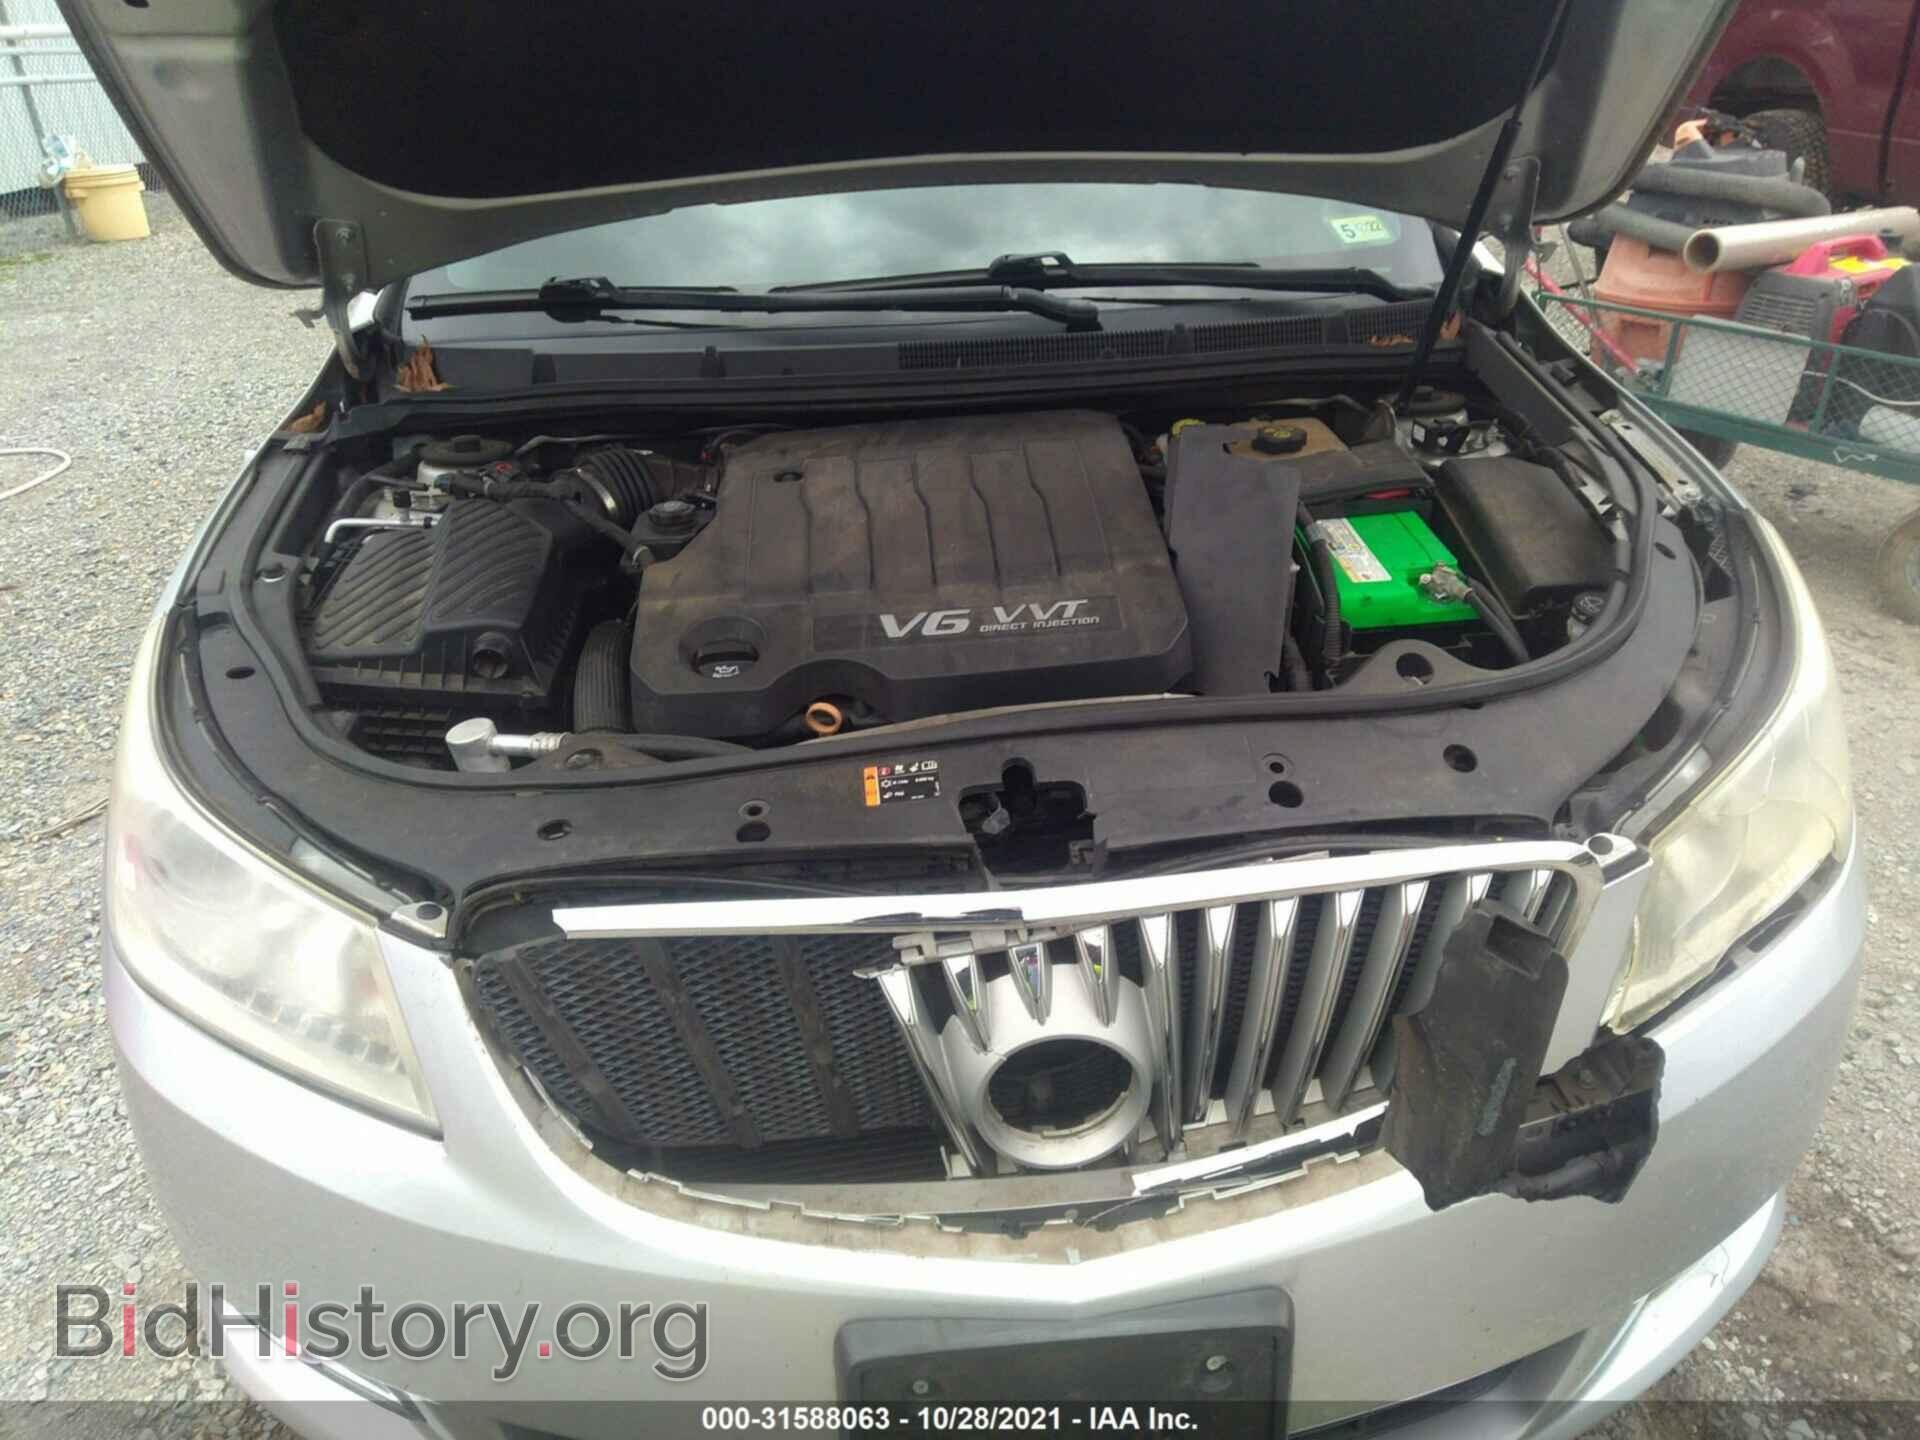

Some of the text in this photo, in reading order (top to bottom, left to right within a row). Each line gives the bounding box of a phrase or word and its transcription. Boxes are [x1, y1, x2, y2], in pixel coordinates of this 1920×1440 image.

[1340, 223, 1357, 240] 5
[879, 599, 1089, 639] V6 VVT
[979, 616, 1100, 633] DIRECT INJECTION
